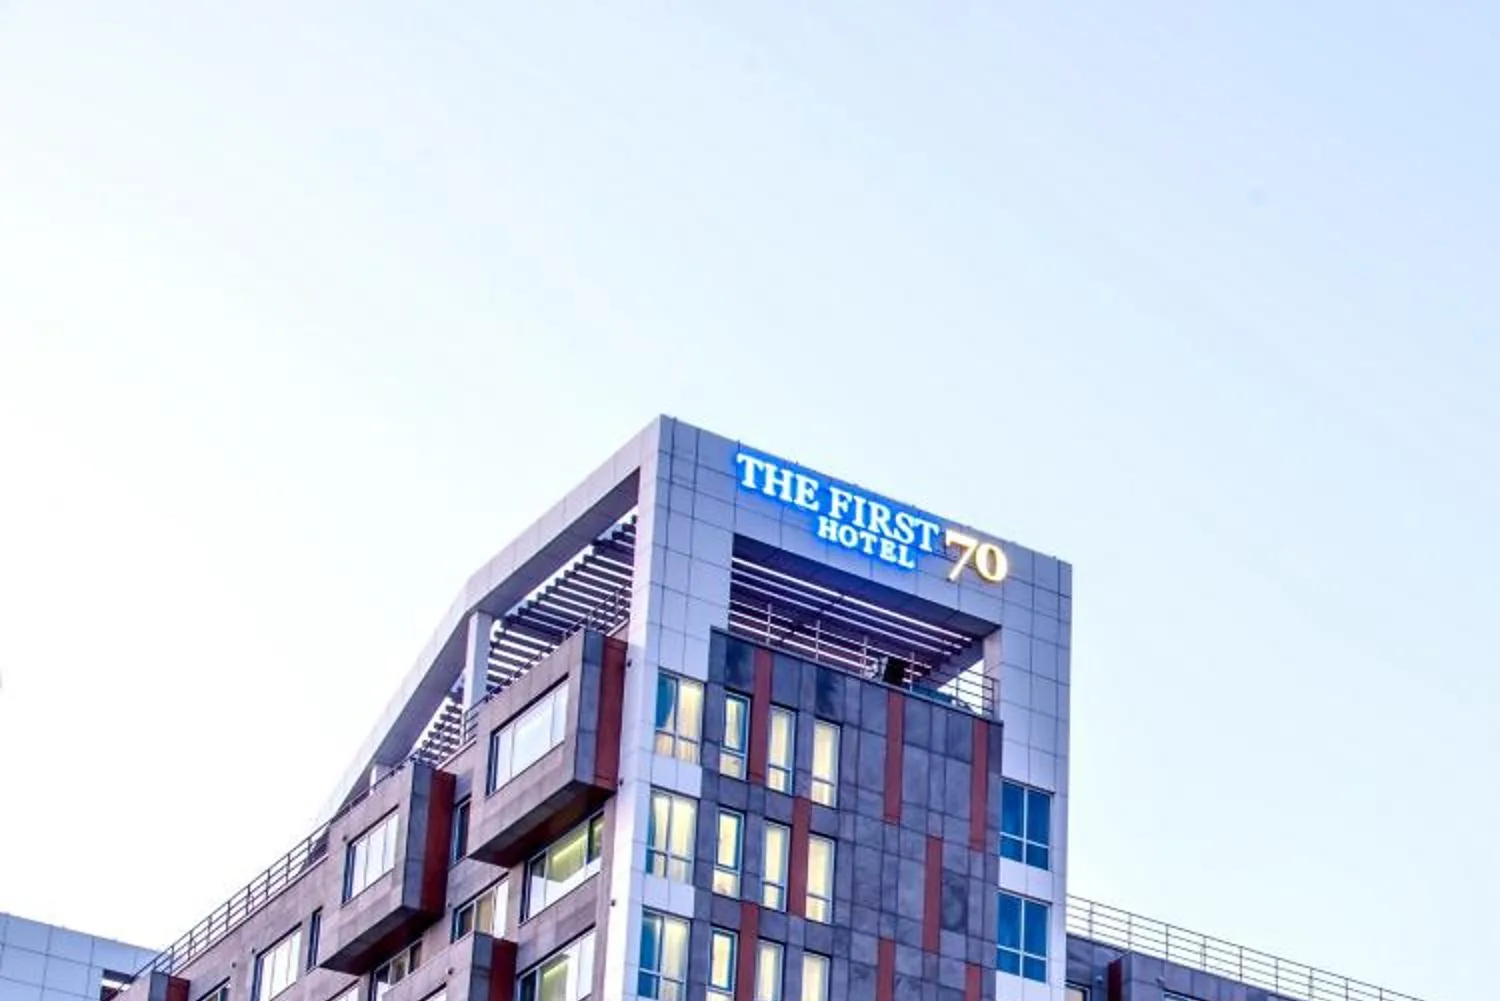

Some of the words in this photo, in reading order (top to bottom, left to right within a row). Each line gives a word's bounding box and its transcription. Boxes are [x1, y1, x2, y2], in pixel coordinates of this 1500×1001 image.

[737, 453, 819, 512] THE
[829, 487, 939, 552] FIRST
[818, 516, 915, 569] HOTEL
[945, 529, 1008, 582] 70
